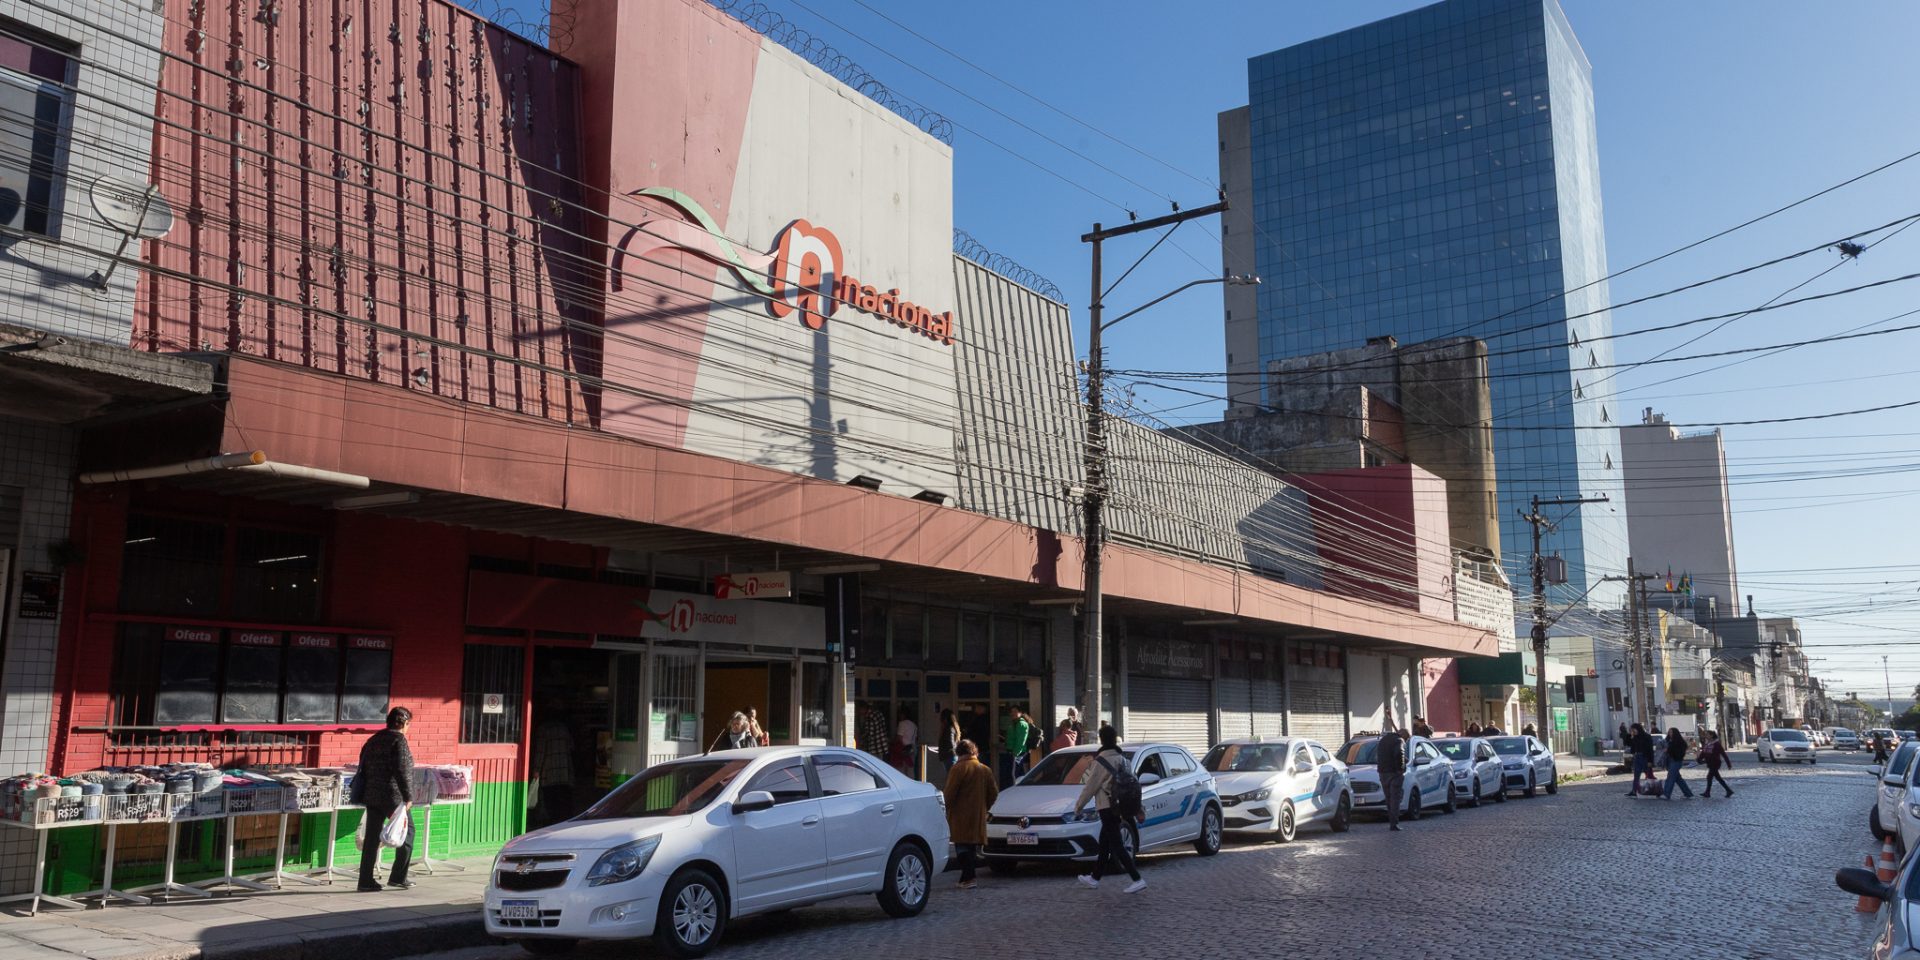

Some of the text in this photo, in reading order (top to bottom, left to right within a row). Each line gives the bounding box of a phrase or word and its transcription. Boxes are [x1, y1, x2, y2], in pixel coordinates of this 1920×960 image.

[841, 274, 955, 345] nacional
[758, 581, 786, 590] nacional
[695, 611, 737, 626] nacional
[174, 629, 212, 642] Oferta
[240, 632, 274, 645] Oferta
[298, 635, 331, 647] Oferta
[356, 637, 387, 649] Oferta
[1137, 648, 1168, 671] Afrodite
